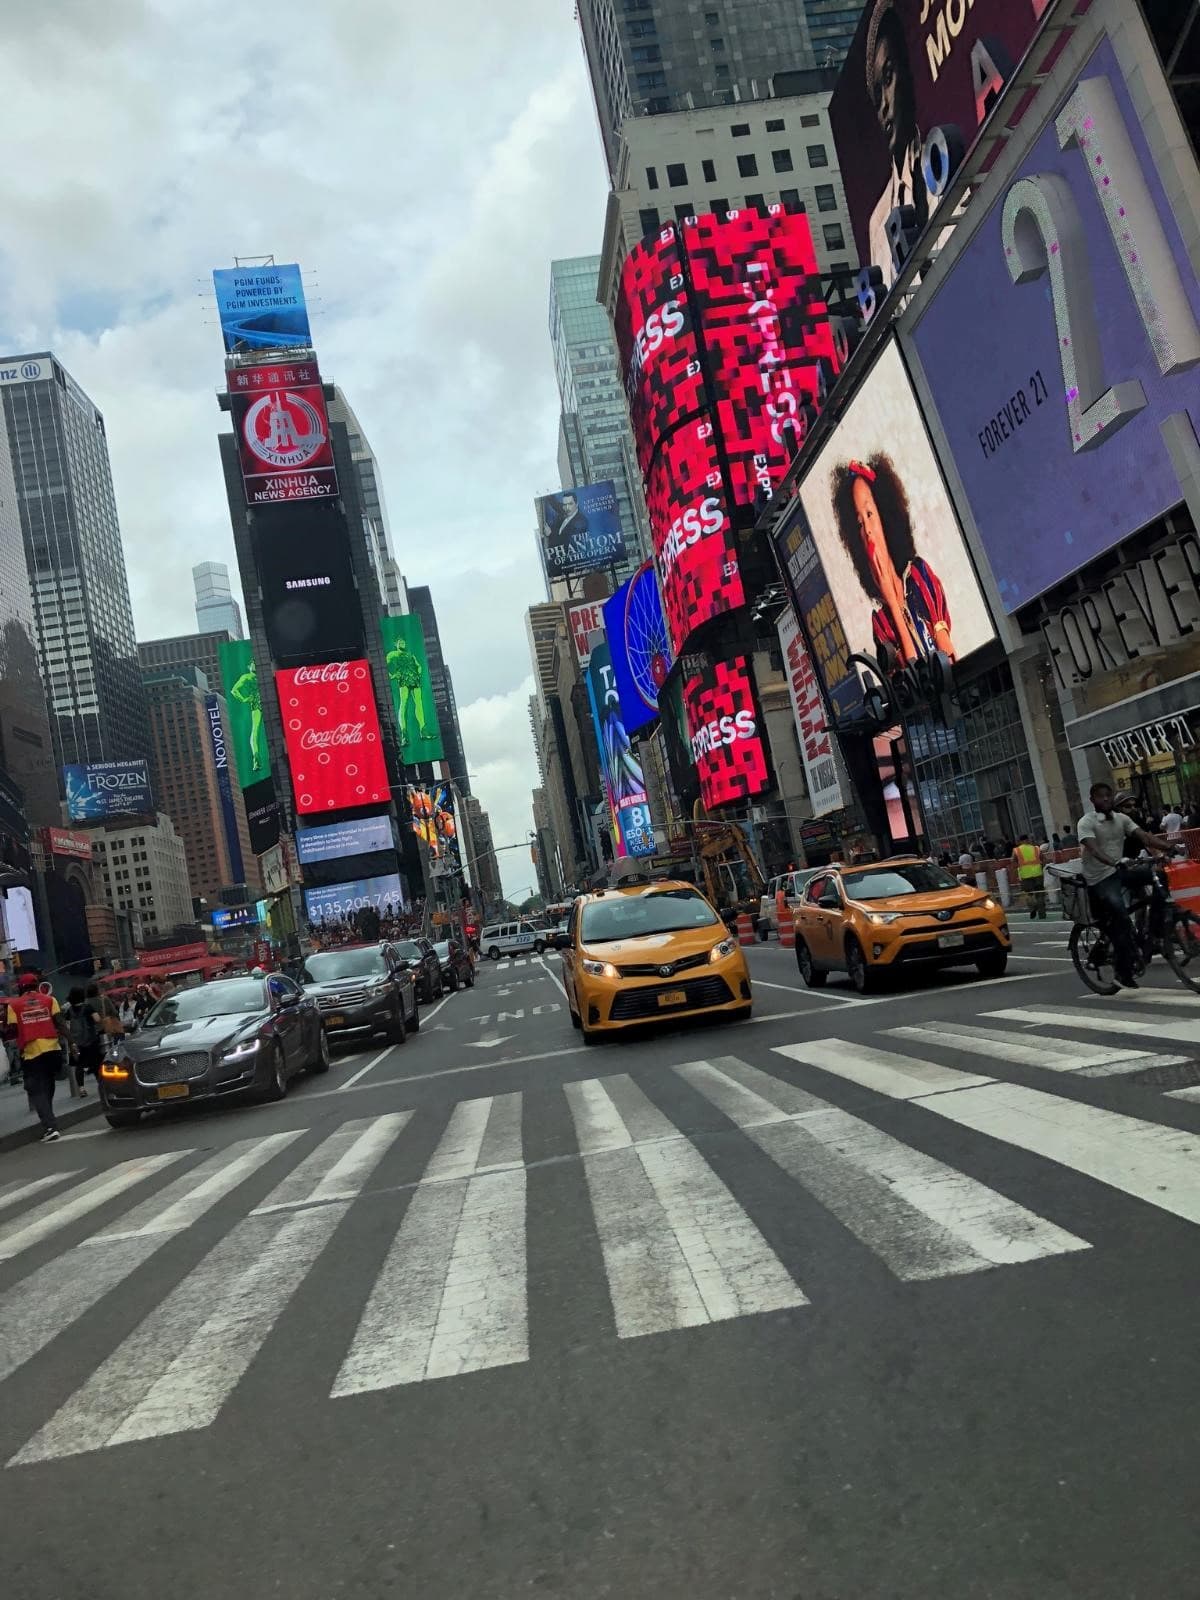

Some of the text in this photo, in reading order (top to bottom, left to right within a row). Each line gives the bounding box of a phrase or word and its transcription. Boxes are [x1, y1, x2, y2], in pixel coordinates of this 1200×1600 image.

[926, 0, 974, 83] MO
[234, 276, 254, 286] PGIM
[235, 286, 283, 297] POWERED BY
[226, 296, 297, 309] PGIM INVESTMENTS
[236, 369, 311, 387] 新华通讯社
[978, 369, 1049, 459] FOREVER 21
[266, 449, 312, 465] XINHUA
[254, 484, 332, 501] NEWS AGENCY
[265, 475, 319, 491] XINHUA
[545, 531, 623, 560] PHANTOM
[572, 531, 591, 543] THE
[554, 554, 567, 566] OF
[569, 550, 585, 562] THE
[586, 545, 617, 559] OPERA
[286, 576, 331, 588] SAMSUNG
[294, 661, 350, 685] Coca-Cola
[786, 638, 819, 763] WOMAN
[210, 702, 227, 769] NOVOTEL
[300, 721, 366, 750] Coca-Cola
[1100, 716, 1196, 768] FOREVER 21
[87, 771, 147, 791] FROZEN
